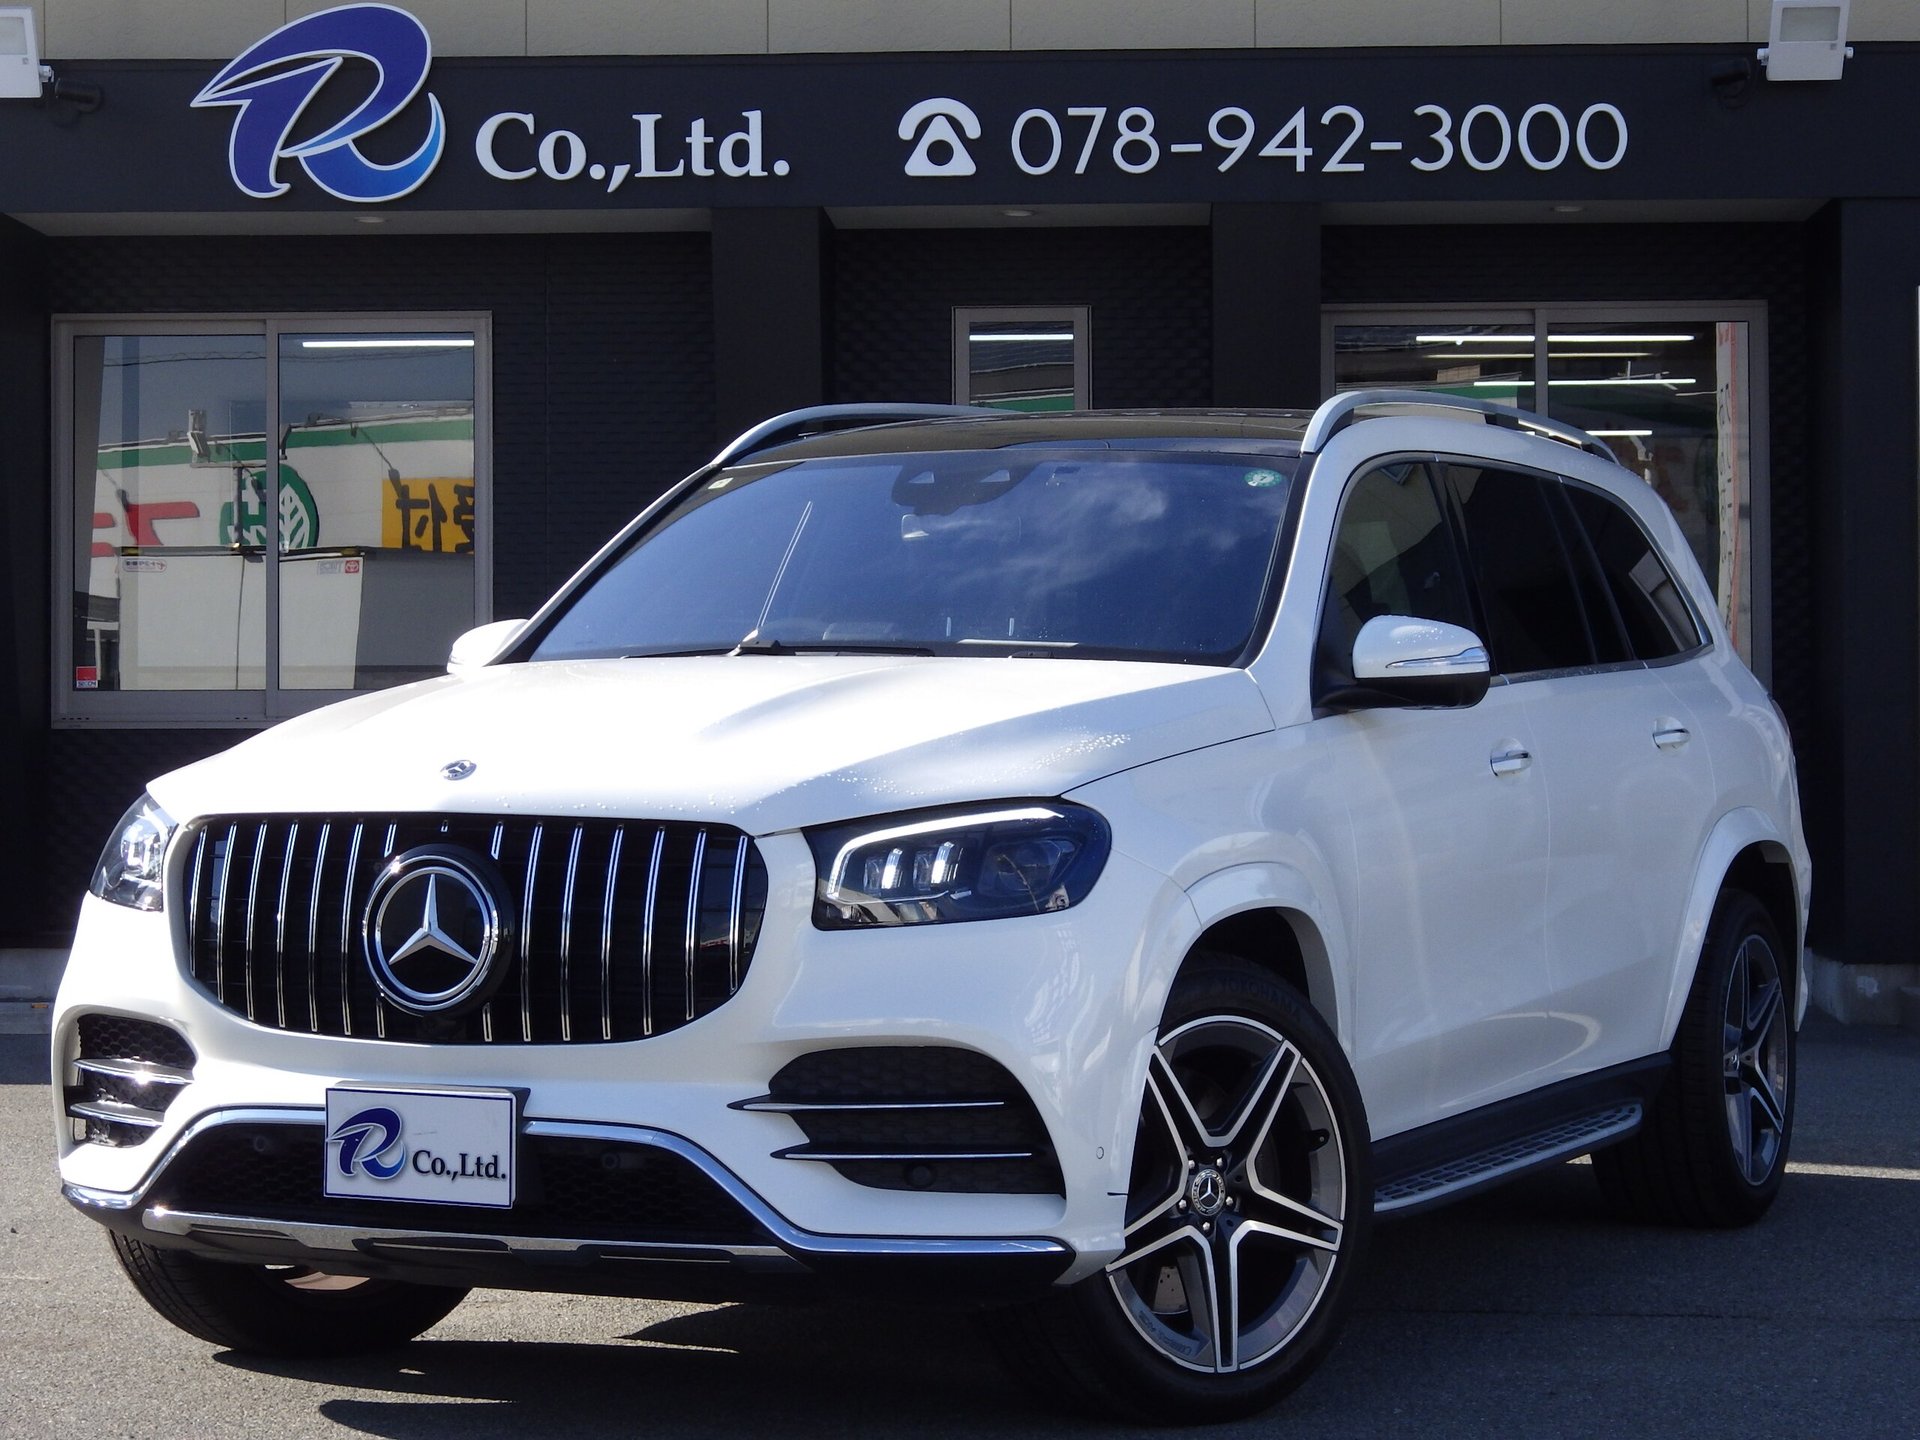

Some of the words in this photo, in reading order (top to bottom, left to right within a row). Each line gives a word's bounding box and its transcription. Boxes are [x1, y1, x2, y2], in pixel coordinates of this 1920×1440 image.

[475, 110, 791, 193] Co.,Ltd.
[1011, 103, 1628, 176] 078-942-3000
[412, 1150, 507, 1182] Co.,Ltd.
